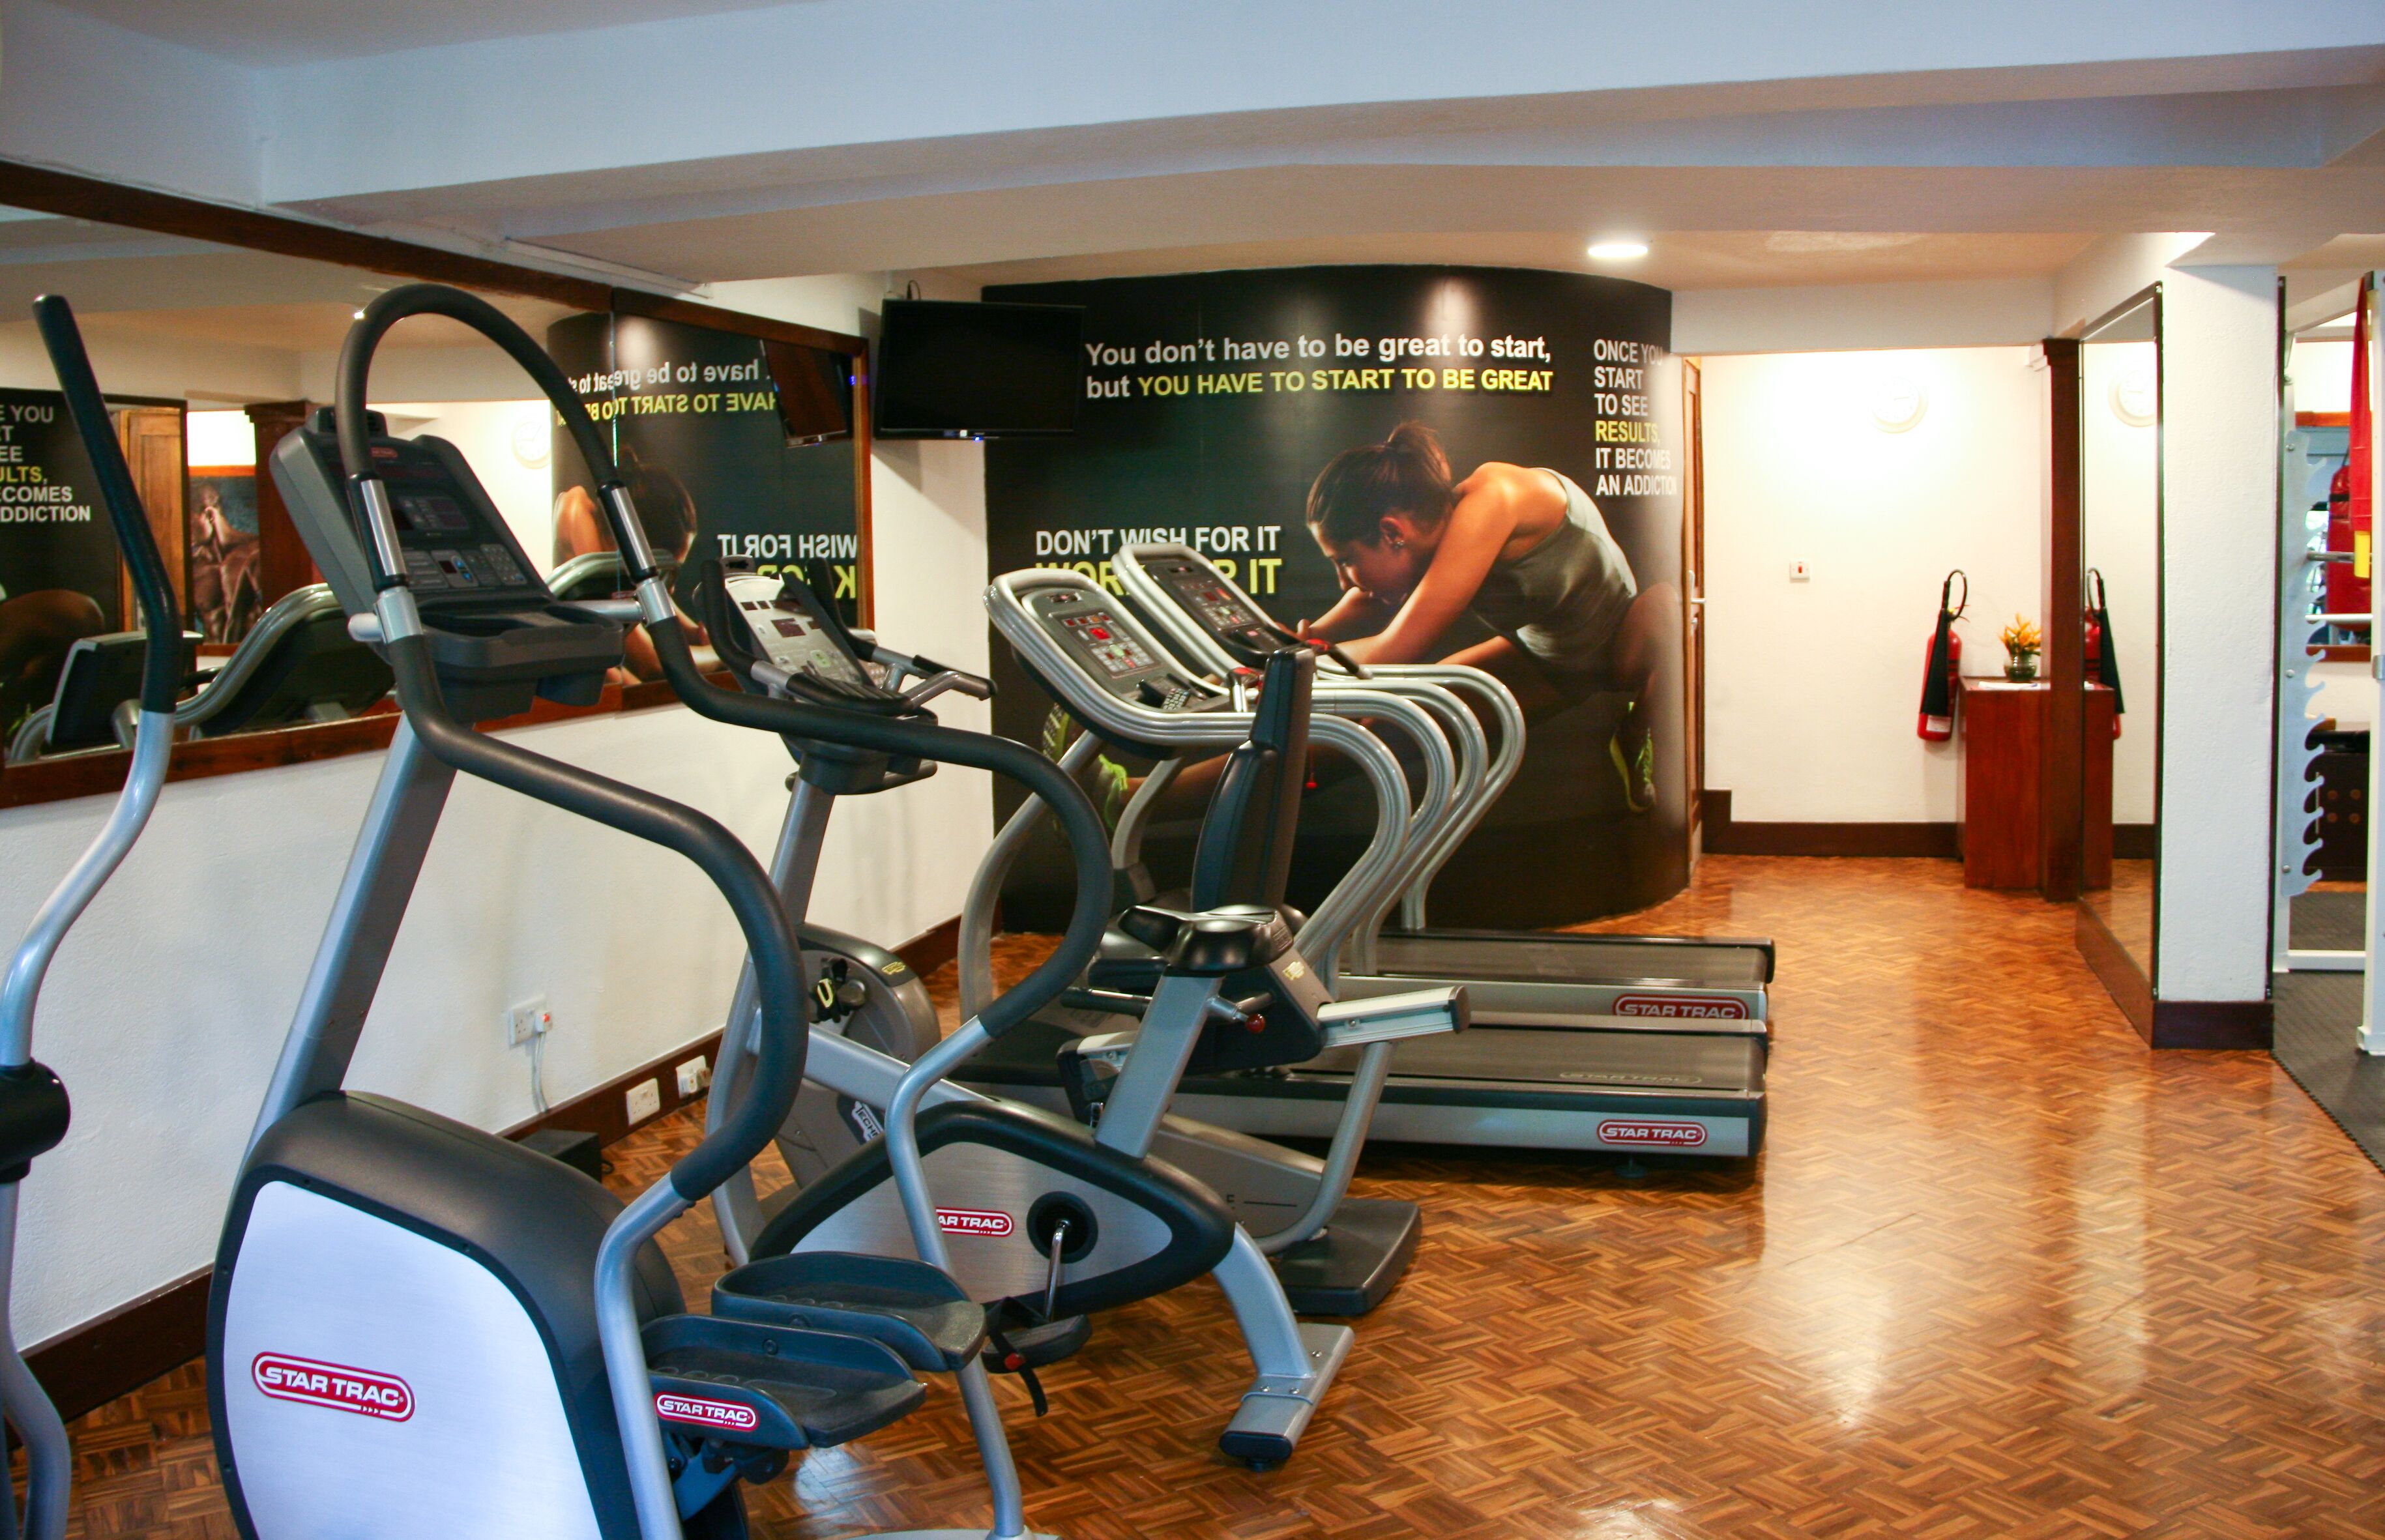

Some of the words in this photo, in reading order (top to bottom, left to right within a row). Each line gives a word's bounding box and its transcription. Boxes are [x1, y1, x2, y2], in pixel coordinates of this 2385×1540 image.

[1085, 343, 1135, 366] You
[1145, 338, 1215, 363] don't
[1224, 337, 1289, 360] have
[1298, 335, 1326, 358] to
[1336, 333, 1369, 357] be
[1378, 334, 1450, 362] great
[1458, 334, 1484, 356] to
[1490, 335, 1551, 363] start,
[1594, 339, 1638, 363] ONCE
[1641, 343, 1663, 366] YOU
[1087, 375, 1130, 398] but
[1137, 375, 1190, 396] YOU
[1197, 372, 1263, 394] HAVE
[1270, 371, 1304, 392] TO
[1311, 368, 1395, 390] START
[1401, 368, 1436, 390] TO
[1442, 368, 1475, 390] BE
[1480, 370, 1553, 391] GREAT
[1594, 366, 1643, 390] START
[10, 405, 53, 423] YOU
[1594, 393, 1618, 415] TO
[1622, 394, 1648, 416] SEE
[1596, 420, 1660, 446] RESULTS,
[1596, 447, 1611, 469] IT
[1615, 447, 1671, 470] BECOMES
[1596, 474, 1620, 496] AN
[1624, 475, 1678, 496] ADDICTION
[1036, 529, 1113, 556] DON'T
[1195, 527, 1250, 553] FOR
[1258, 526, 1281, 551] IT
[1250, 559, 1282, 594] IT
[1625, 1004, 1676, 1016] STAR
[1680, 1006, 1736, 1018] TRAC
[1605, 1127, 1648, 1137] STAR
[1651, 1129, 1697, 1139] TRAC
[960, 1217, 1004, 1228] TRAC
[262, 1367, 328, 1393] STAR
[331, 1378, 400, 1406] TRAC
[661, 1400, 703, 1416] STAR
[705, 1406, 748, 1422] TRAC
